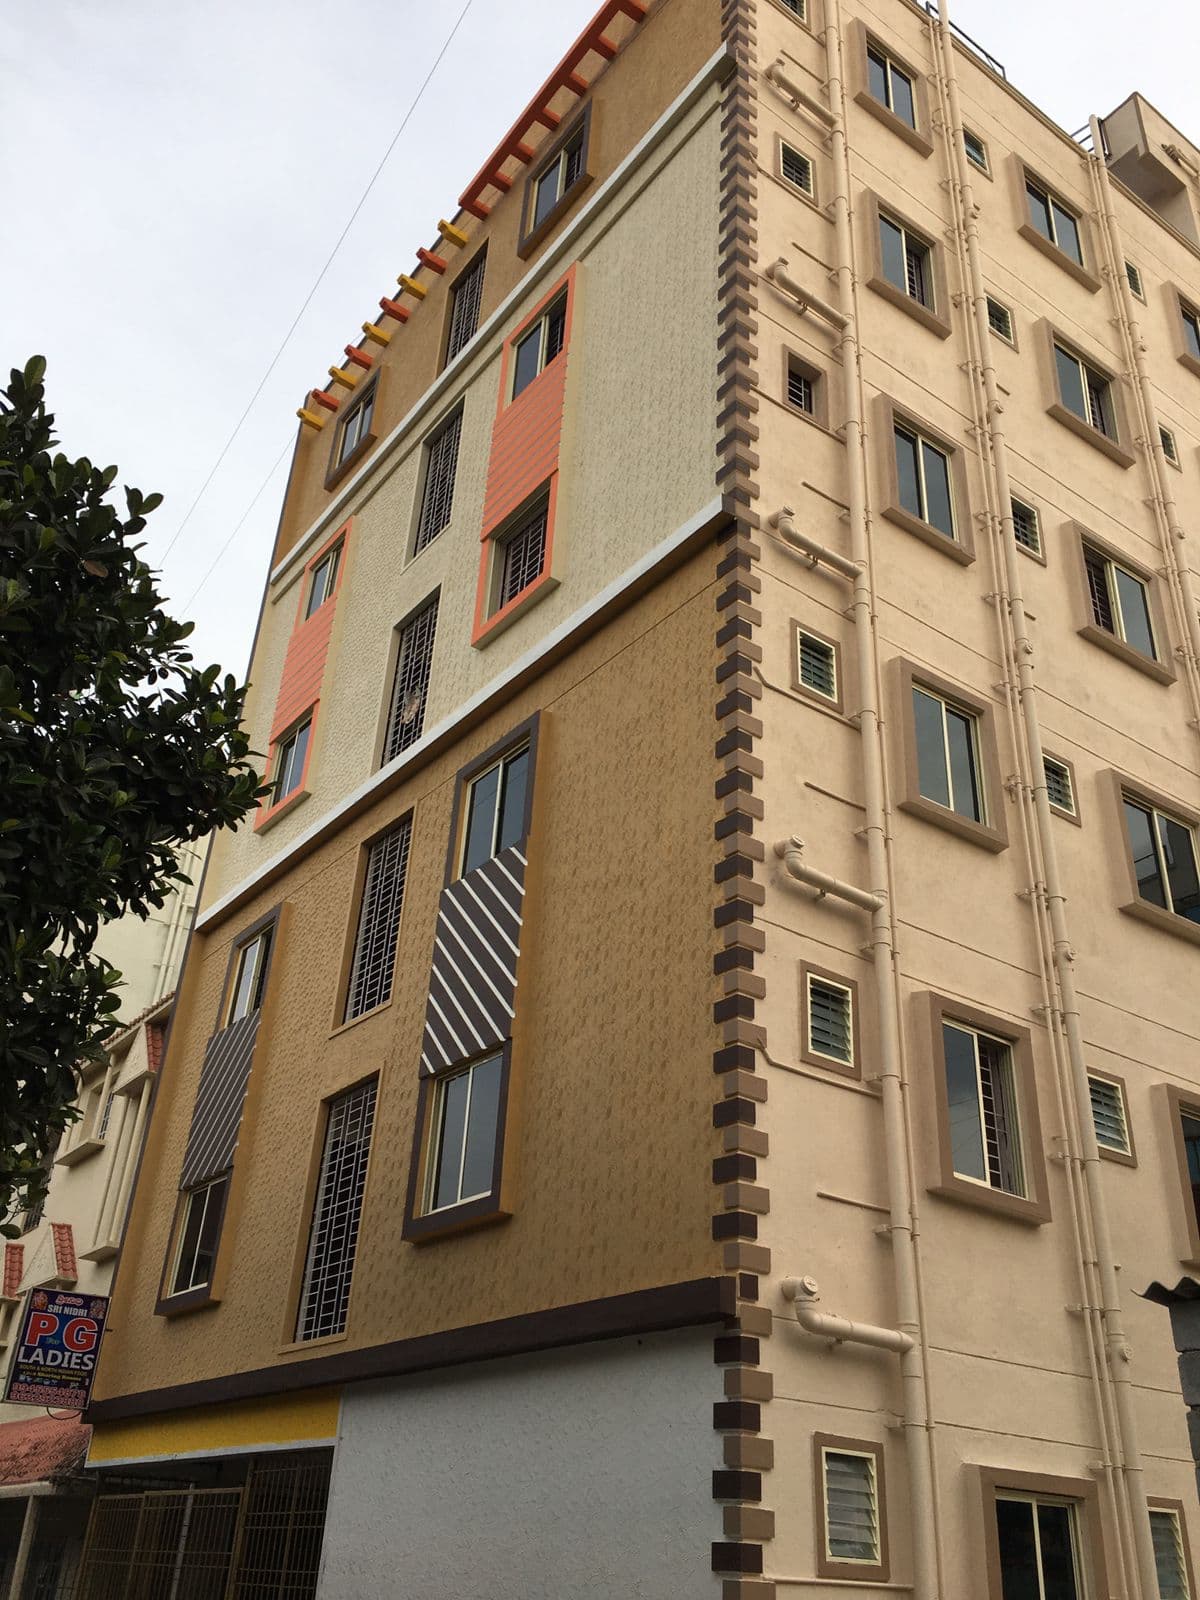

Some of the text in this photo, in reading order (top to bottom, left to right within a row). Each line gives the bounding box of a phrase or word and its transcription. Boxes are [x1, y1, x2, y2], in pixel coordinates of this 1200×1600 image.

[47, 1304, 88, 1317] SRI NIDHI
[17, 1346, 95, 1371] LADIES
